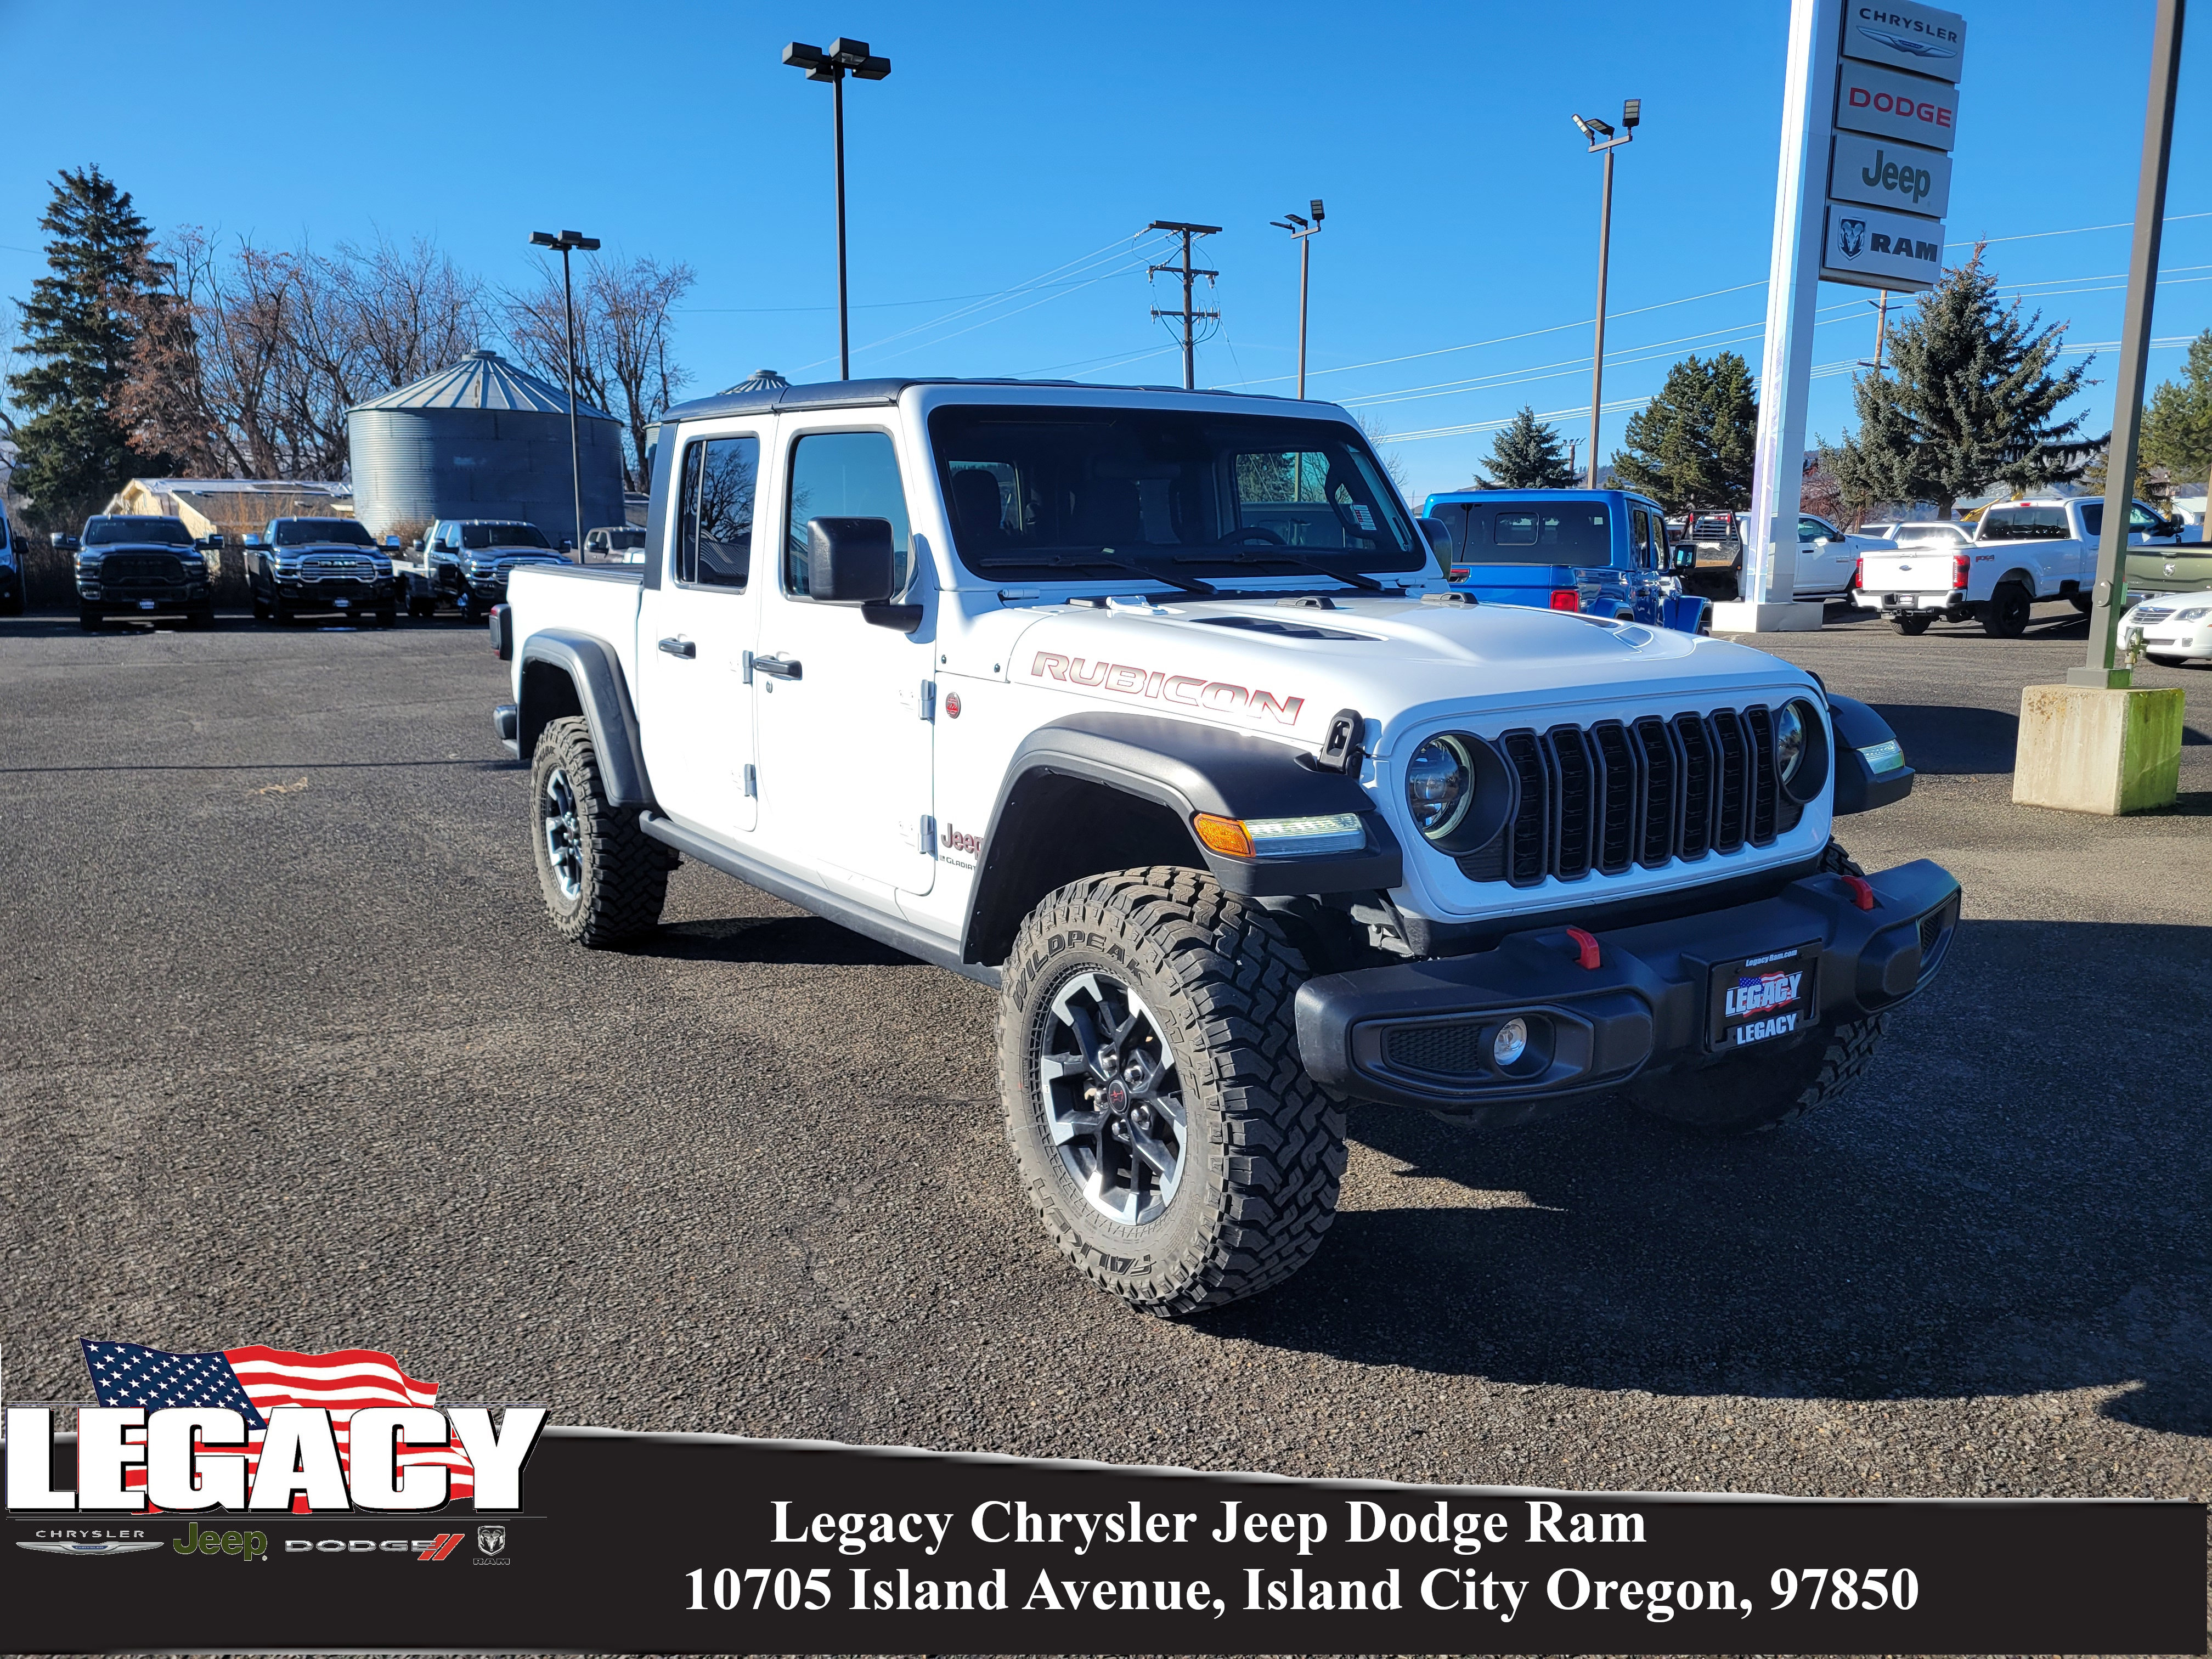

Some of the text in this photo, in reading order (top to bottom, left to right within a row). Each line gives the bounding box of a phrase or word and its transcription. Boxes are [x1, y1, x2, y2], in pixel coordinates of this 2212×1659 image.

[1859, 8, 1957, 44] CHRYSLER
[1849, 87, 1953, 128] DODGE
[1861, 149, 1931, 204] Jeep
[1870, 232, 1938, 263] RAM
[1031, 651, 1305, 726] RUBICON
[946, 856, 977, 871] GLADIAT
[1012, 929, 1153, 1013] WILDPEAK
[1725, 973, 1802, 1016] LEGACY
[1737, 1013, 1797, 1045] LEGACY
[1032, 1177, 1158, 1278] FALKEN
